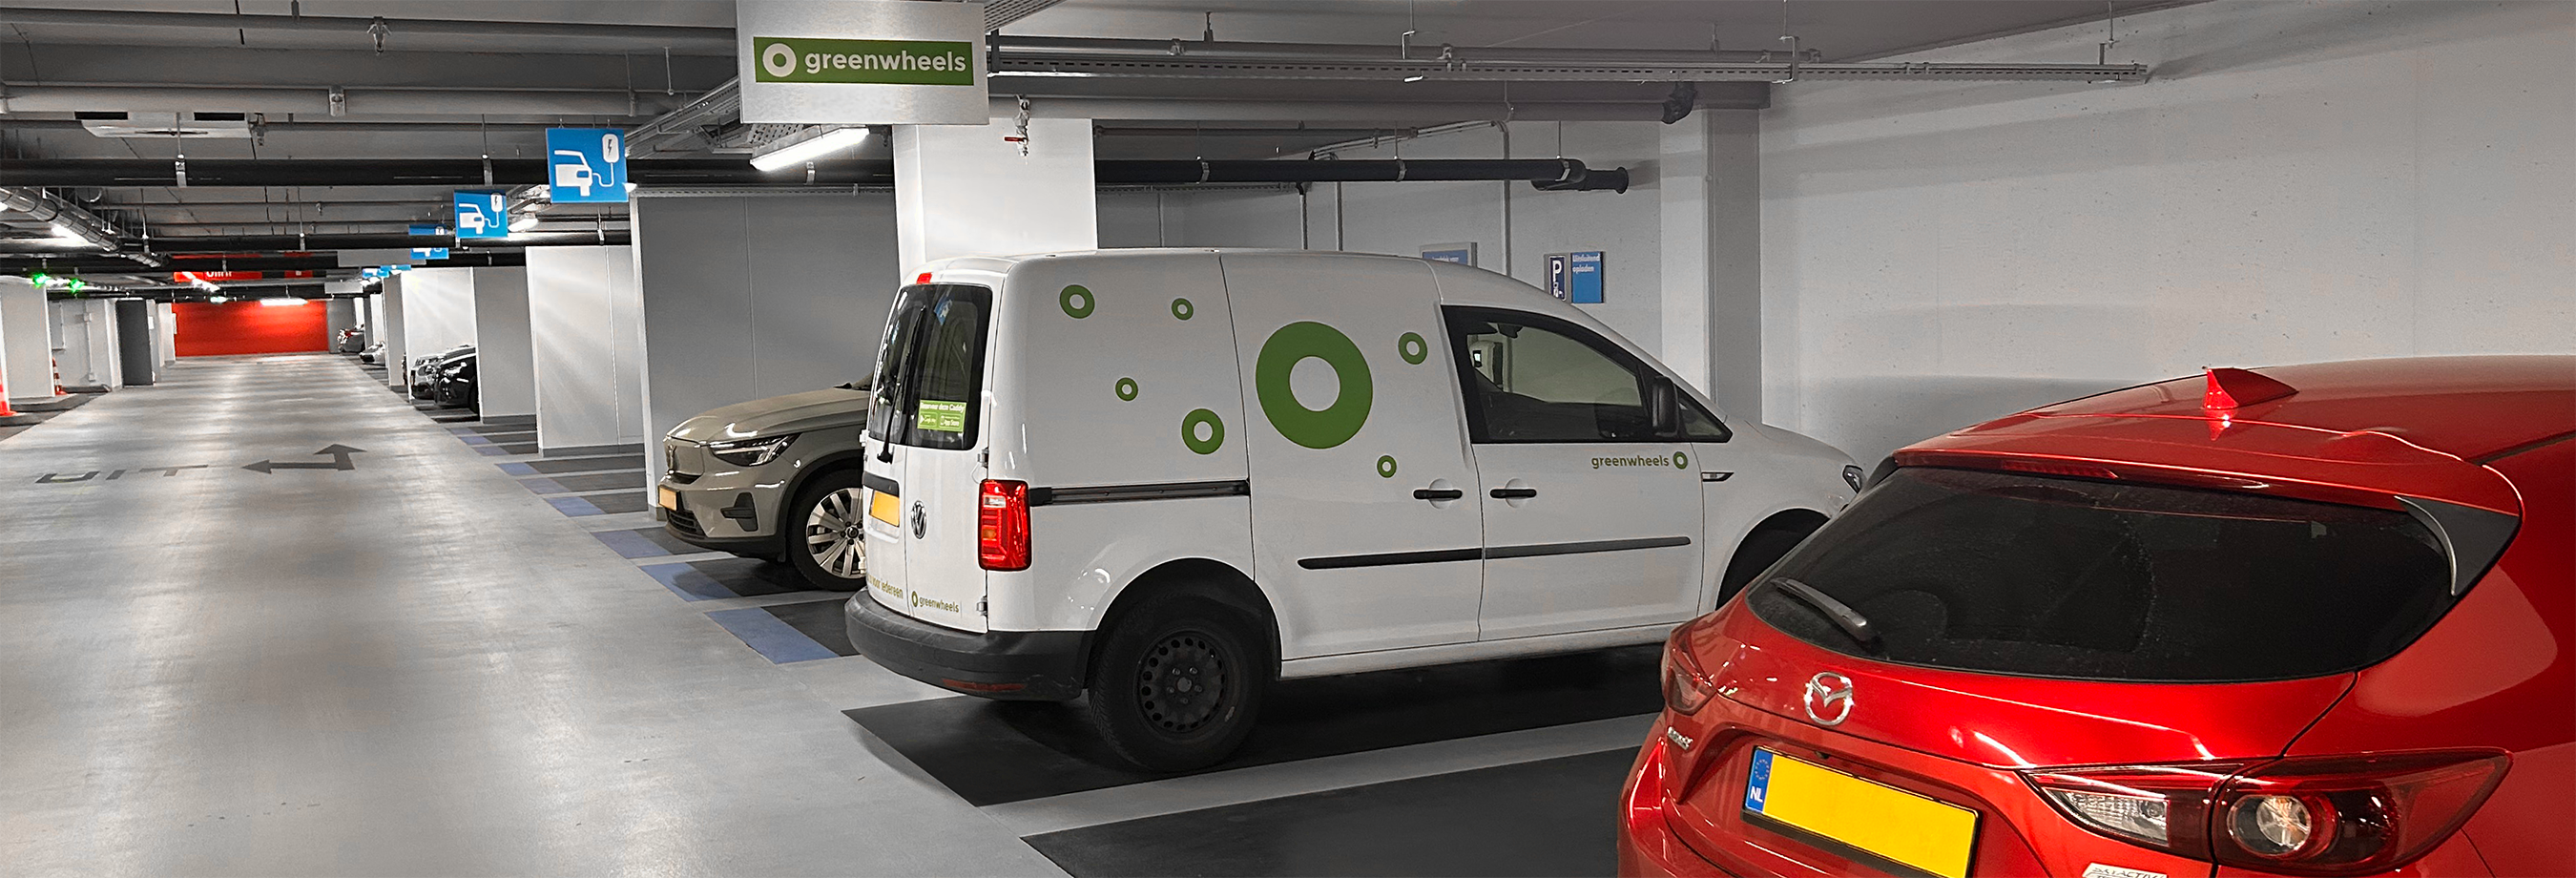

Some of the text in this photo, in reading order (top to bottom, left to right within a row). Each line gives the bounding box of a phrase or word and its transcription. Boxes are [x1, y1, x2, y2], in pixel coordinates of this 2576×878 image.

[804, 50, 966, 74] greenwheels
[1552, 260, 1562, 282] P
[1591, 454, 1670, 470] greenwheels
[919, 596, 959, 613] greenwheels
[1750, 785, 1763, 803] NL
